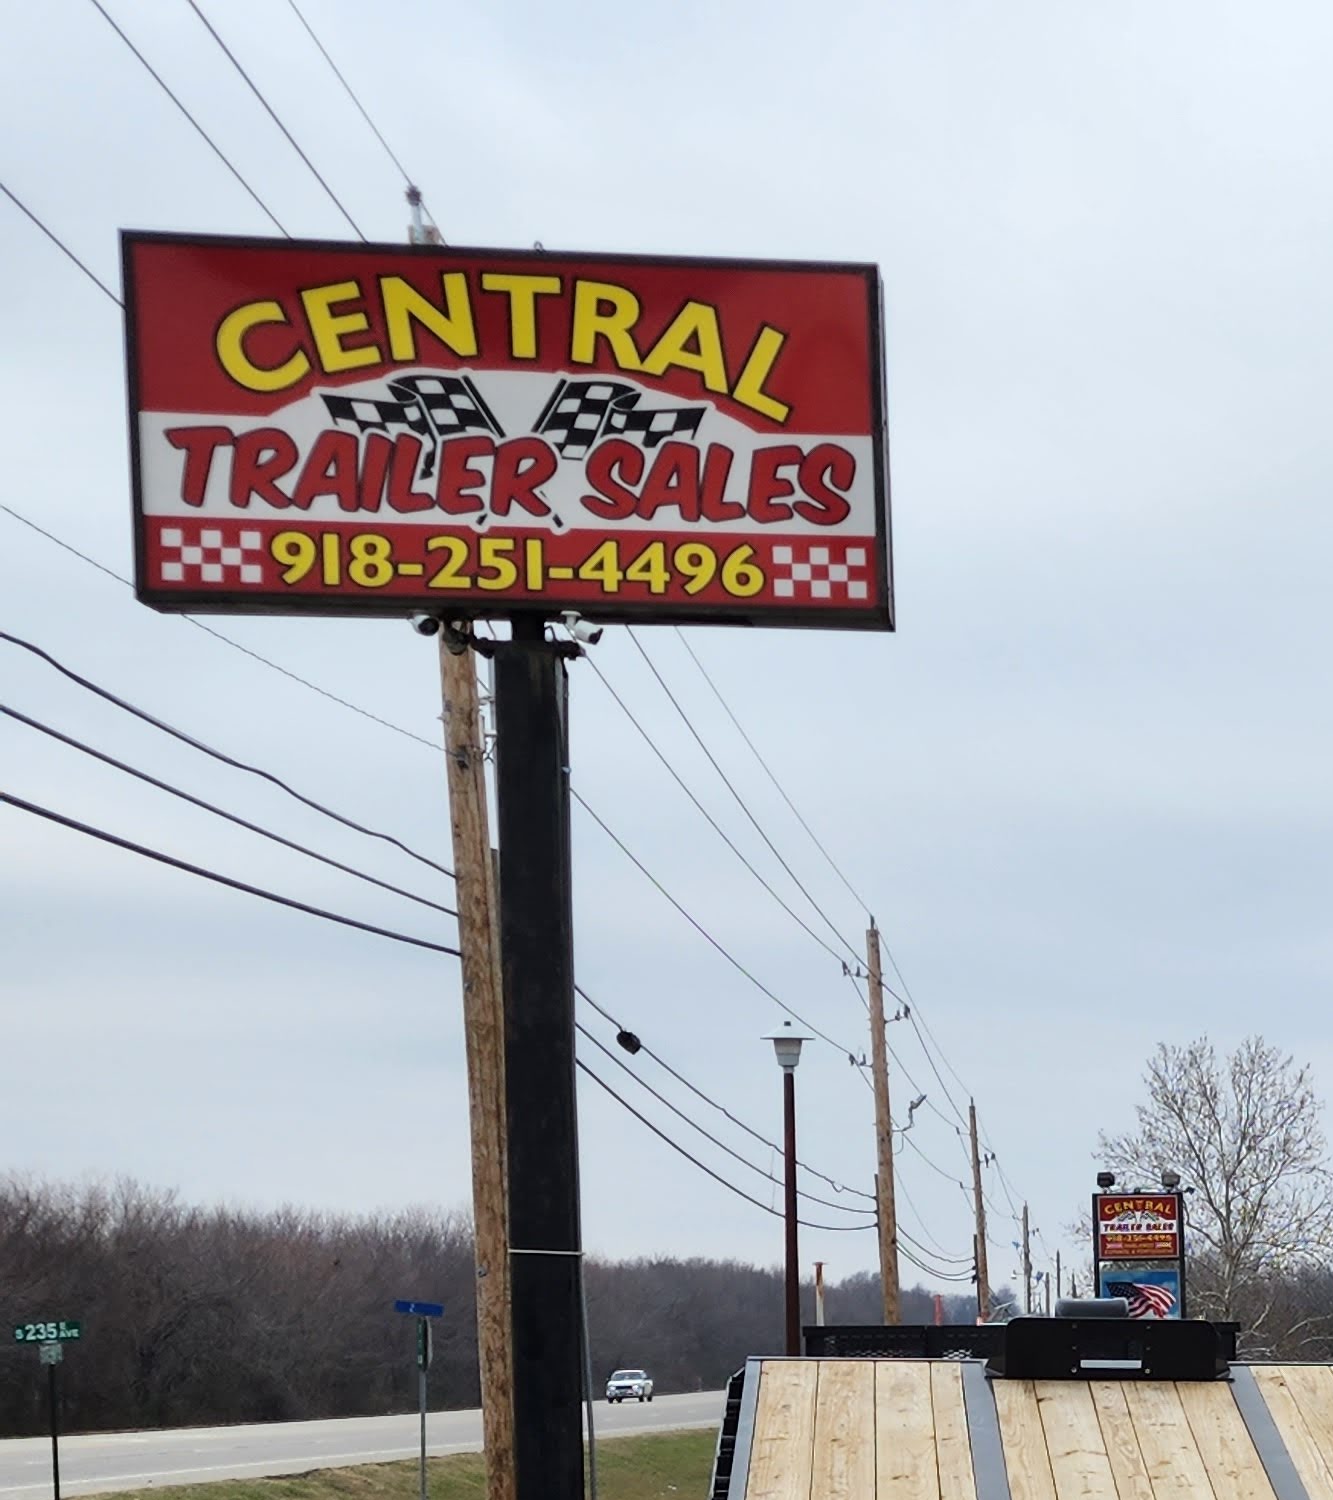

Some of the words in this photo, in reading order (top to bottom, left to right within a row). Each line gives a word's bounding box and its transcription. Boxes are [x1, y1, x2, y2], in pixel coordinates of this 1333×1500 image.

[214, 270, 793, 424] CENTRAL
[165, 424, 560, 520] TRAILER
[579, 437, 856, 526] SALES
[269, 529, 766, 599] 918-251-4496
[1103, 1223, 1142, 1232] TRAILER
[1146, 1222, 1174, 1231] SALES
[1104, 1200, 1172, 1214] CENTRAL
[15, 1329, 24, 1340] S
[25, 1322, 58, 1341] 235
[59, 1328, 79, 1337] AVE
